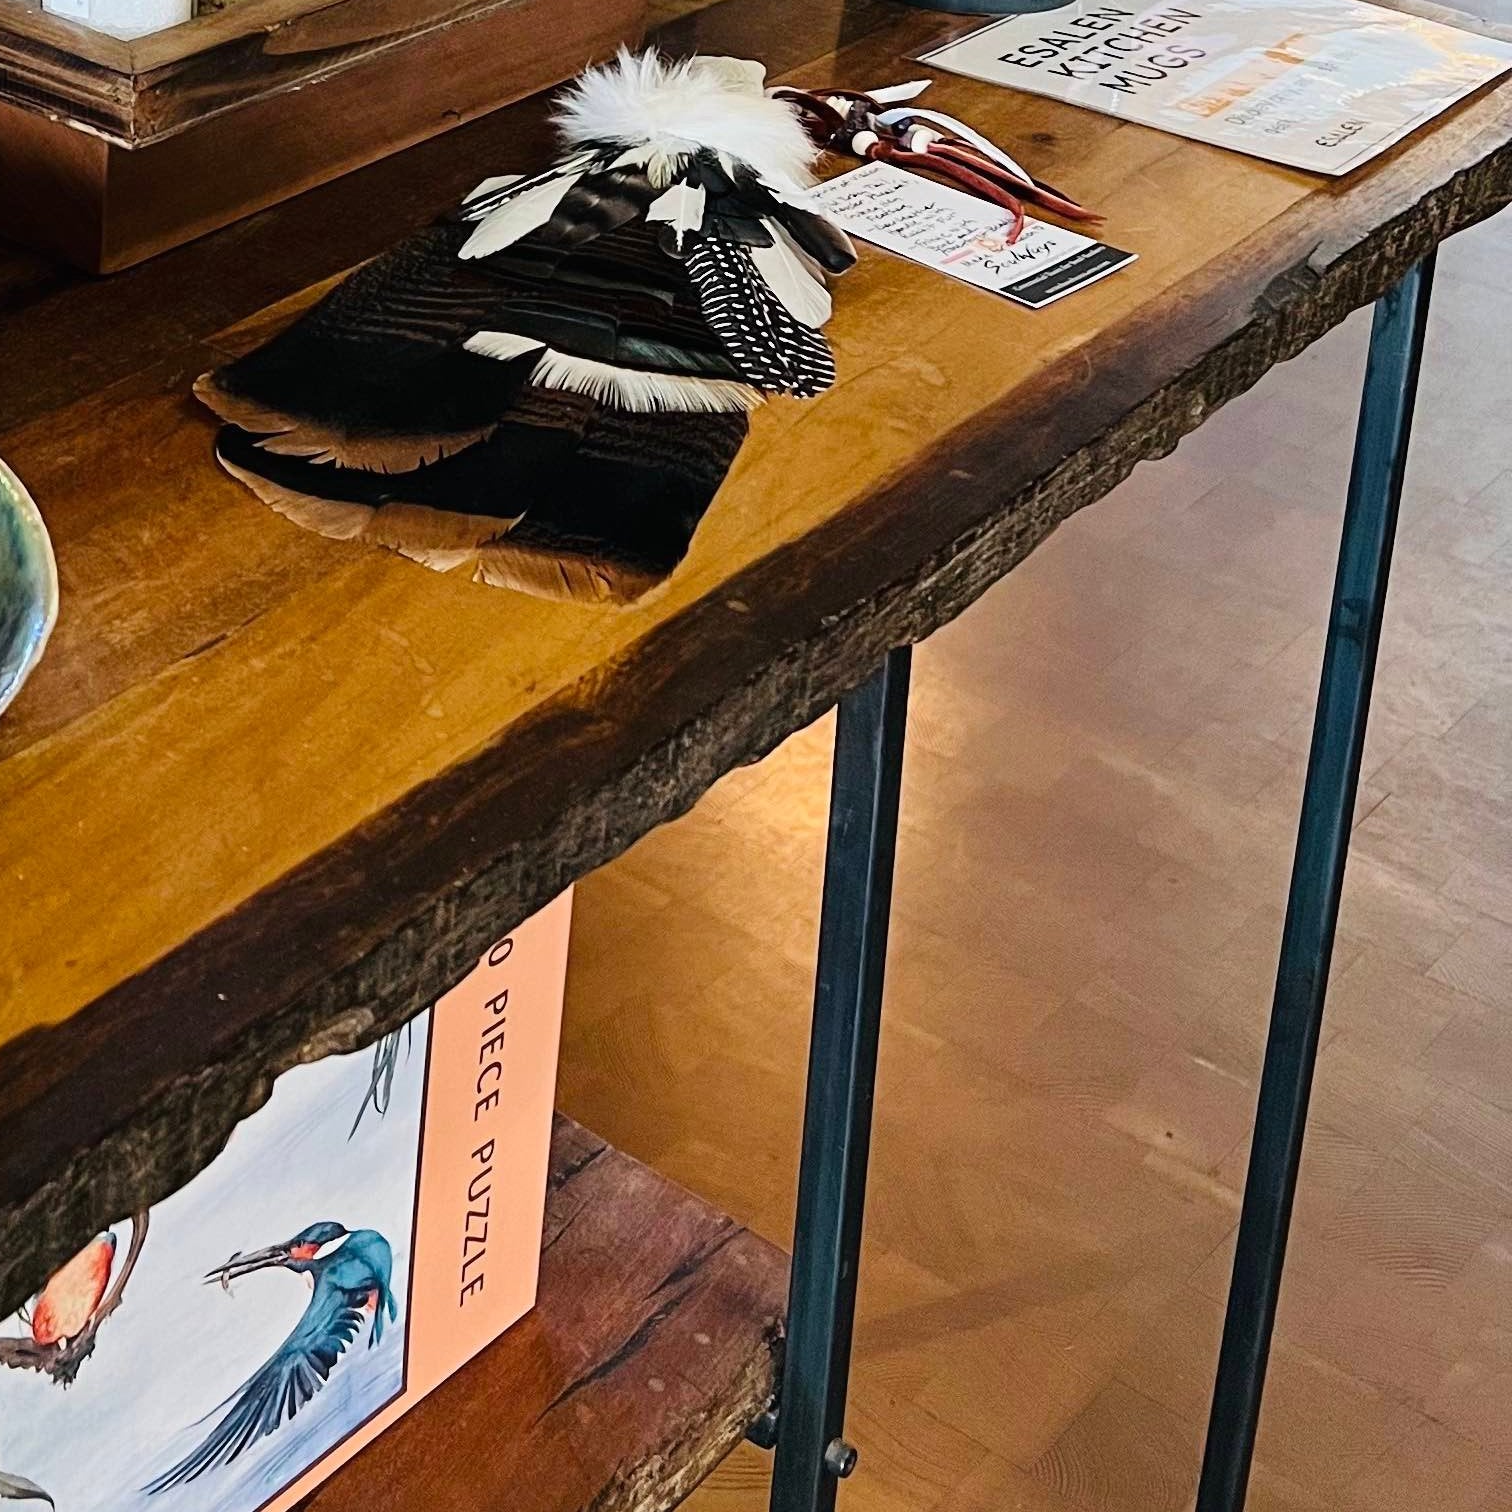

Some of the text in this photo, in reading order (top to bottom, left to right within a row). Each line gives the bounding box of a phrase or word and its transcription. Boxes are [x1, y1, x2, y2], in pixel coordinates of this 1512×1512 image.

[998, 7, 1135, 68] ESALEN
[1048, 7, 1202, 80] KITCHEN
[1099, 44, 1207, 95] MUGS
[474, 989, 509, 1122] PIECE
[460, 1138, 496, 1308] PUZZLE
